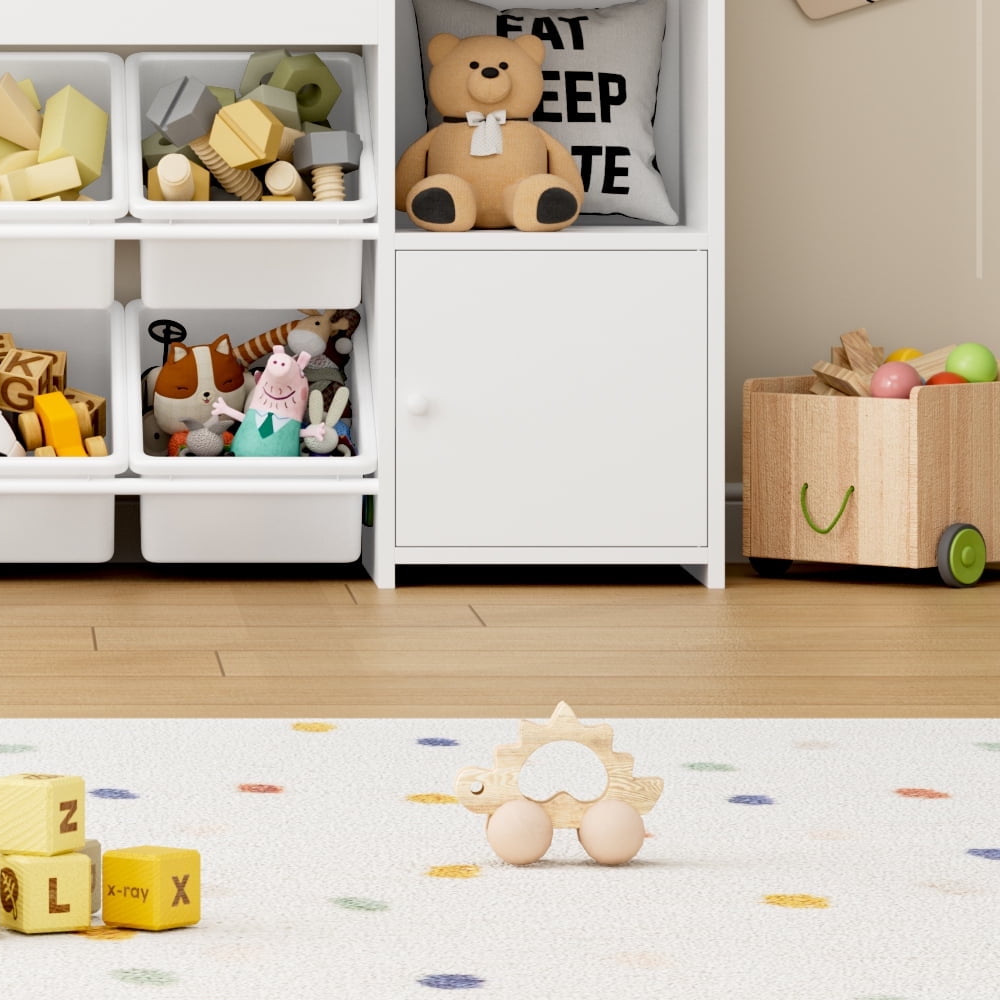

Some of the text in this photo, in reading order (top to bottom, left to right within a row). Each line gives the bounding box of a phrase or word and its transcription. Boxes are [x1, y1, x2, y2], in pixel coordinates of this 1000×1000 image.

[496, 14, 589, 50] EAT
[532, 71, 627, 123] EEP
[5, 352, 44, 376] K
[0, 376, 35, 411] G
[48, 877, 70, 914] L
[107, 884, 149, 903] x-ray
[171, 874, 190, 907] X
